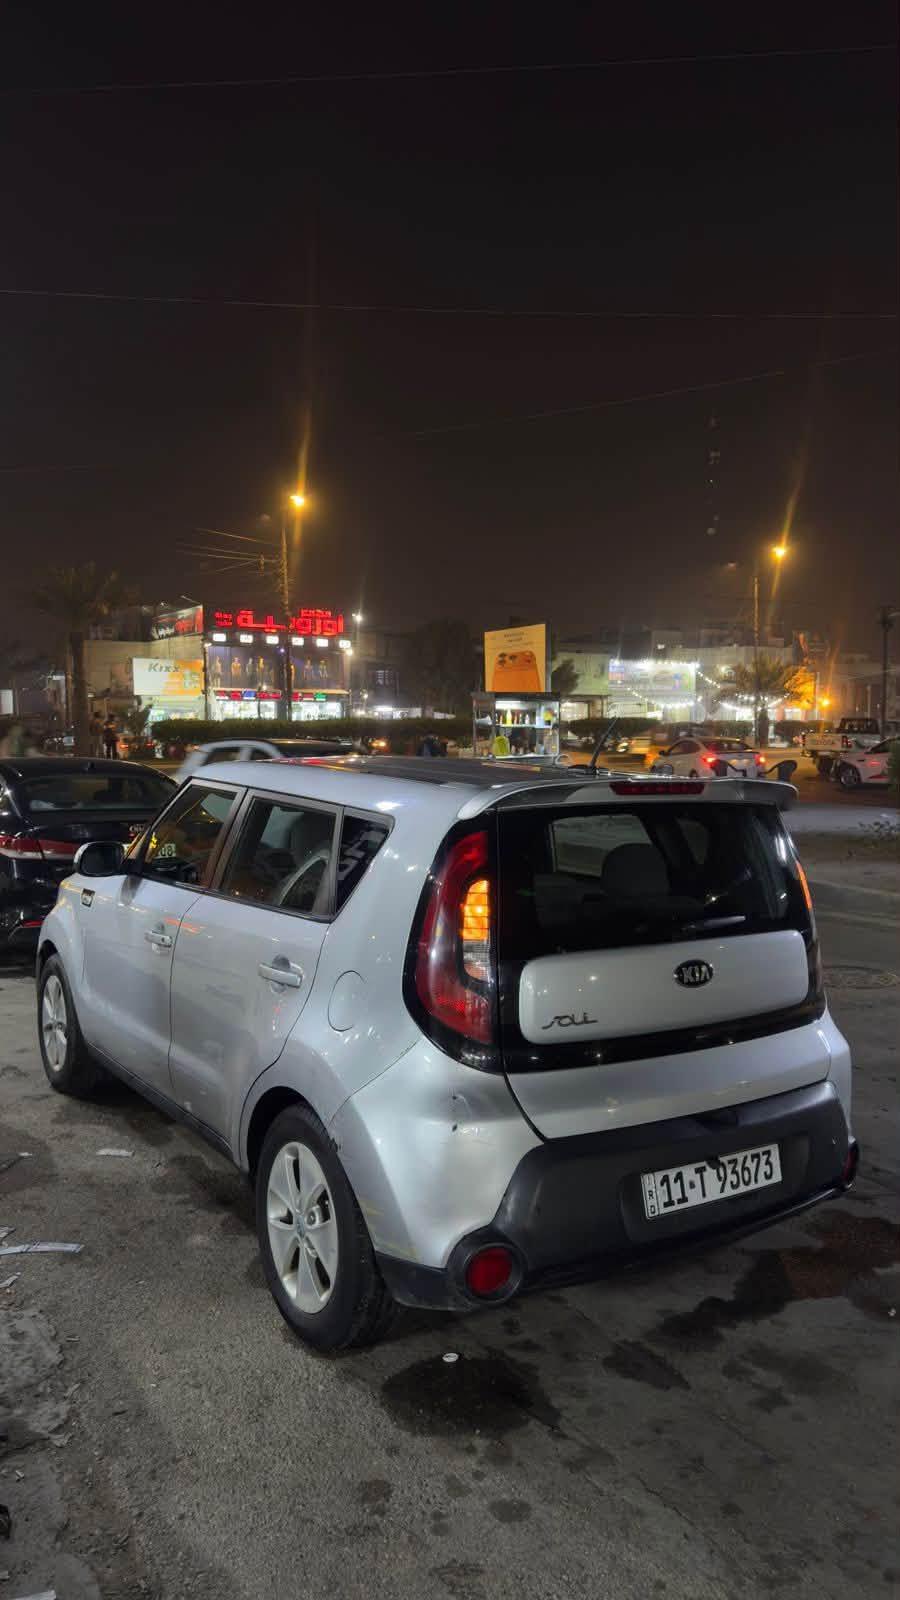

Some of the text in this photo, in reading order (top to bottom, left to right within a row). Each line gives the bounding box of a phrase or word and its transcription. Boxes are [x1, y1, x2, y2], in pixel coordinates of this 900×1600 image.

[148, 663, 179, 673] Kixx
[681, 964, 710, 984] KIA
[715, 1149, 773, 1194] 93673
